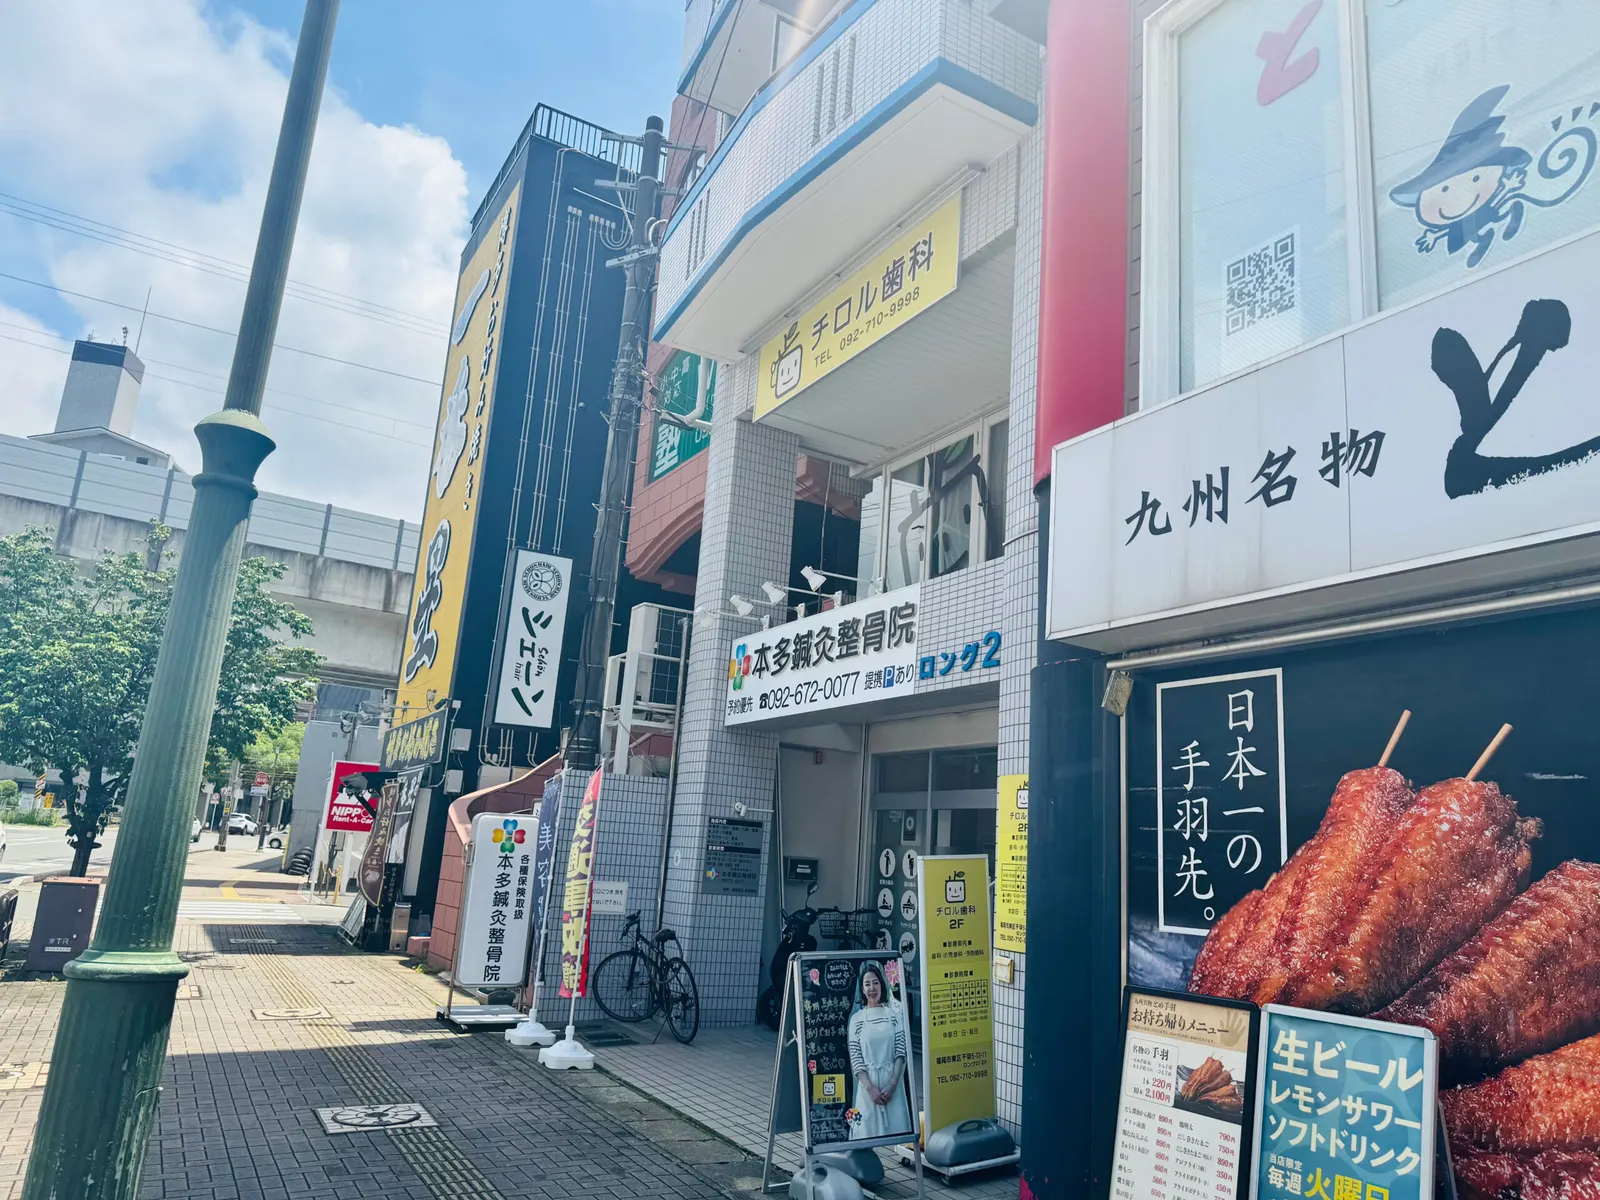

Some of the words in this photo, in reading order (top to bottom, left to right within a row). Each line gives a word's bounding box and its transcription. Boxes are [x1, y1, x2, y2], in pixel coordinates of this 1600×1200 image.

[811, 232, 934, 351] チロル歯科
[814, 349, 833, 368] TEL
[840, 286, 920, 351] 092-710-9998
[1125, 428, 1386, 546] 九州名物
[752, 602, 916, 680] 本多鍼灸整骨院
[919, 631, 1002, 680] ロング2
[514, 662, 524, 681] hair
[535, 647, 549, 677] Schön
[727, 695, 754, 716] 予約優先
[768, 671, 860, 710] 092-672-0077
[1221, 689, 1267, 875] 日本一の
[331, 805, 373, 818] NIPPO
[1172, 740, 1215, 921] 手羽先。
[513, 854, 531, 921] 各種保険取扱
[483, 854, 514, 983] 本多鍼灸整骨院
[936, 905, 976, 916] チロル歯科
[949, 919, 964, 929] 2F
[1131, 1008, 1229, 1034] お持ち帰りメニュー
[1272, 1029, 1424, 1092] 生ビール
[937, 1075, 950, 1084] TEL
[950, 1069, 988, 1082] 092-710-9998
[1151, 1077, 1172, 1091] 220円
[1145, 1088, 1171, 1103] 2,100円
[1269, 1080, 1422, 1132] レモンサワー
[1218, 1145, 1235, 1156] 750円
[1219, 1132, 1236, 1143] 790円
[1268, 1114, 1421, 1176] ソフトドリンク
[1216, 1170, 1233, 1182] 350円
[1269, 1153, 1303, 1172] 当店限定
[1268, 1166, 1302, 1196] 毎週
